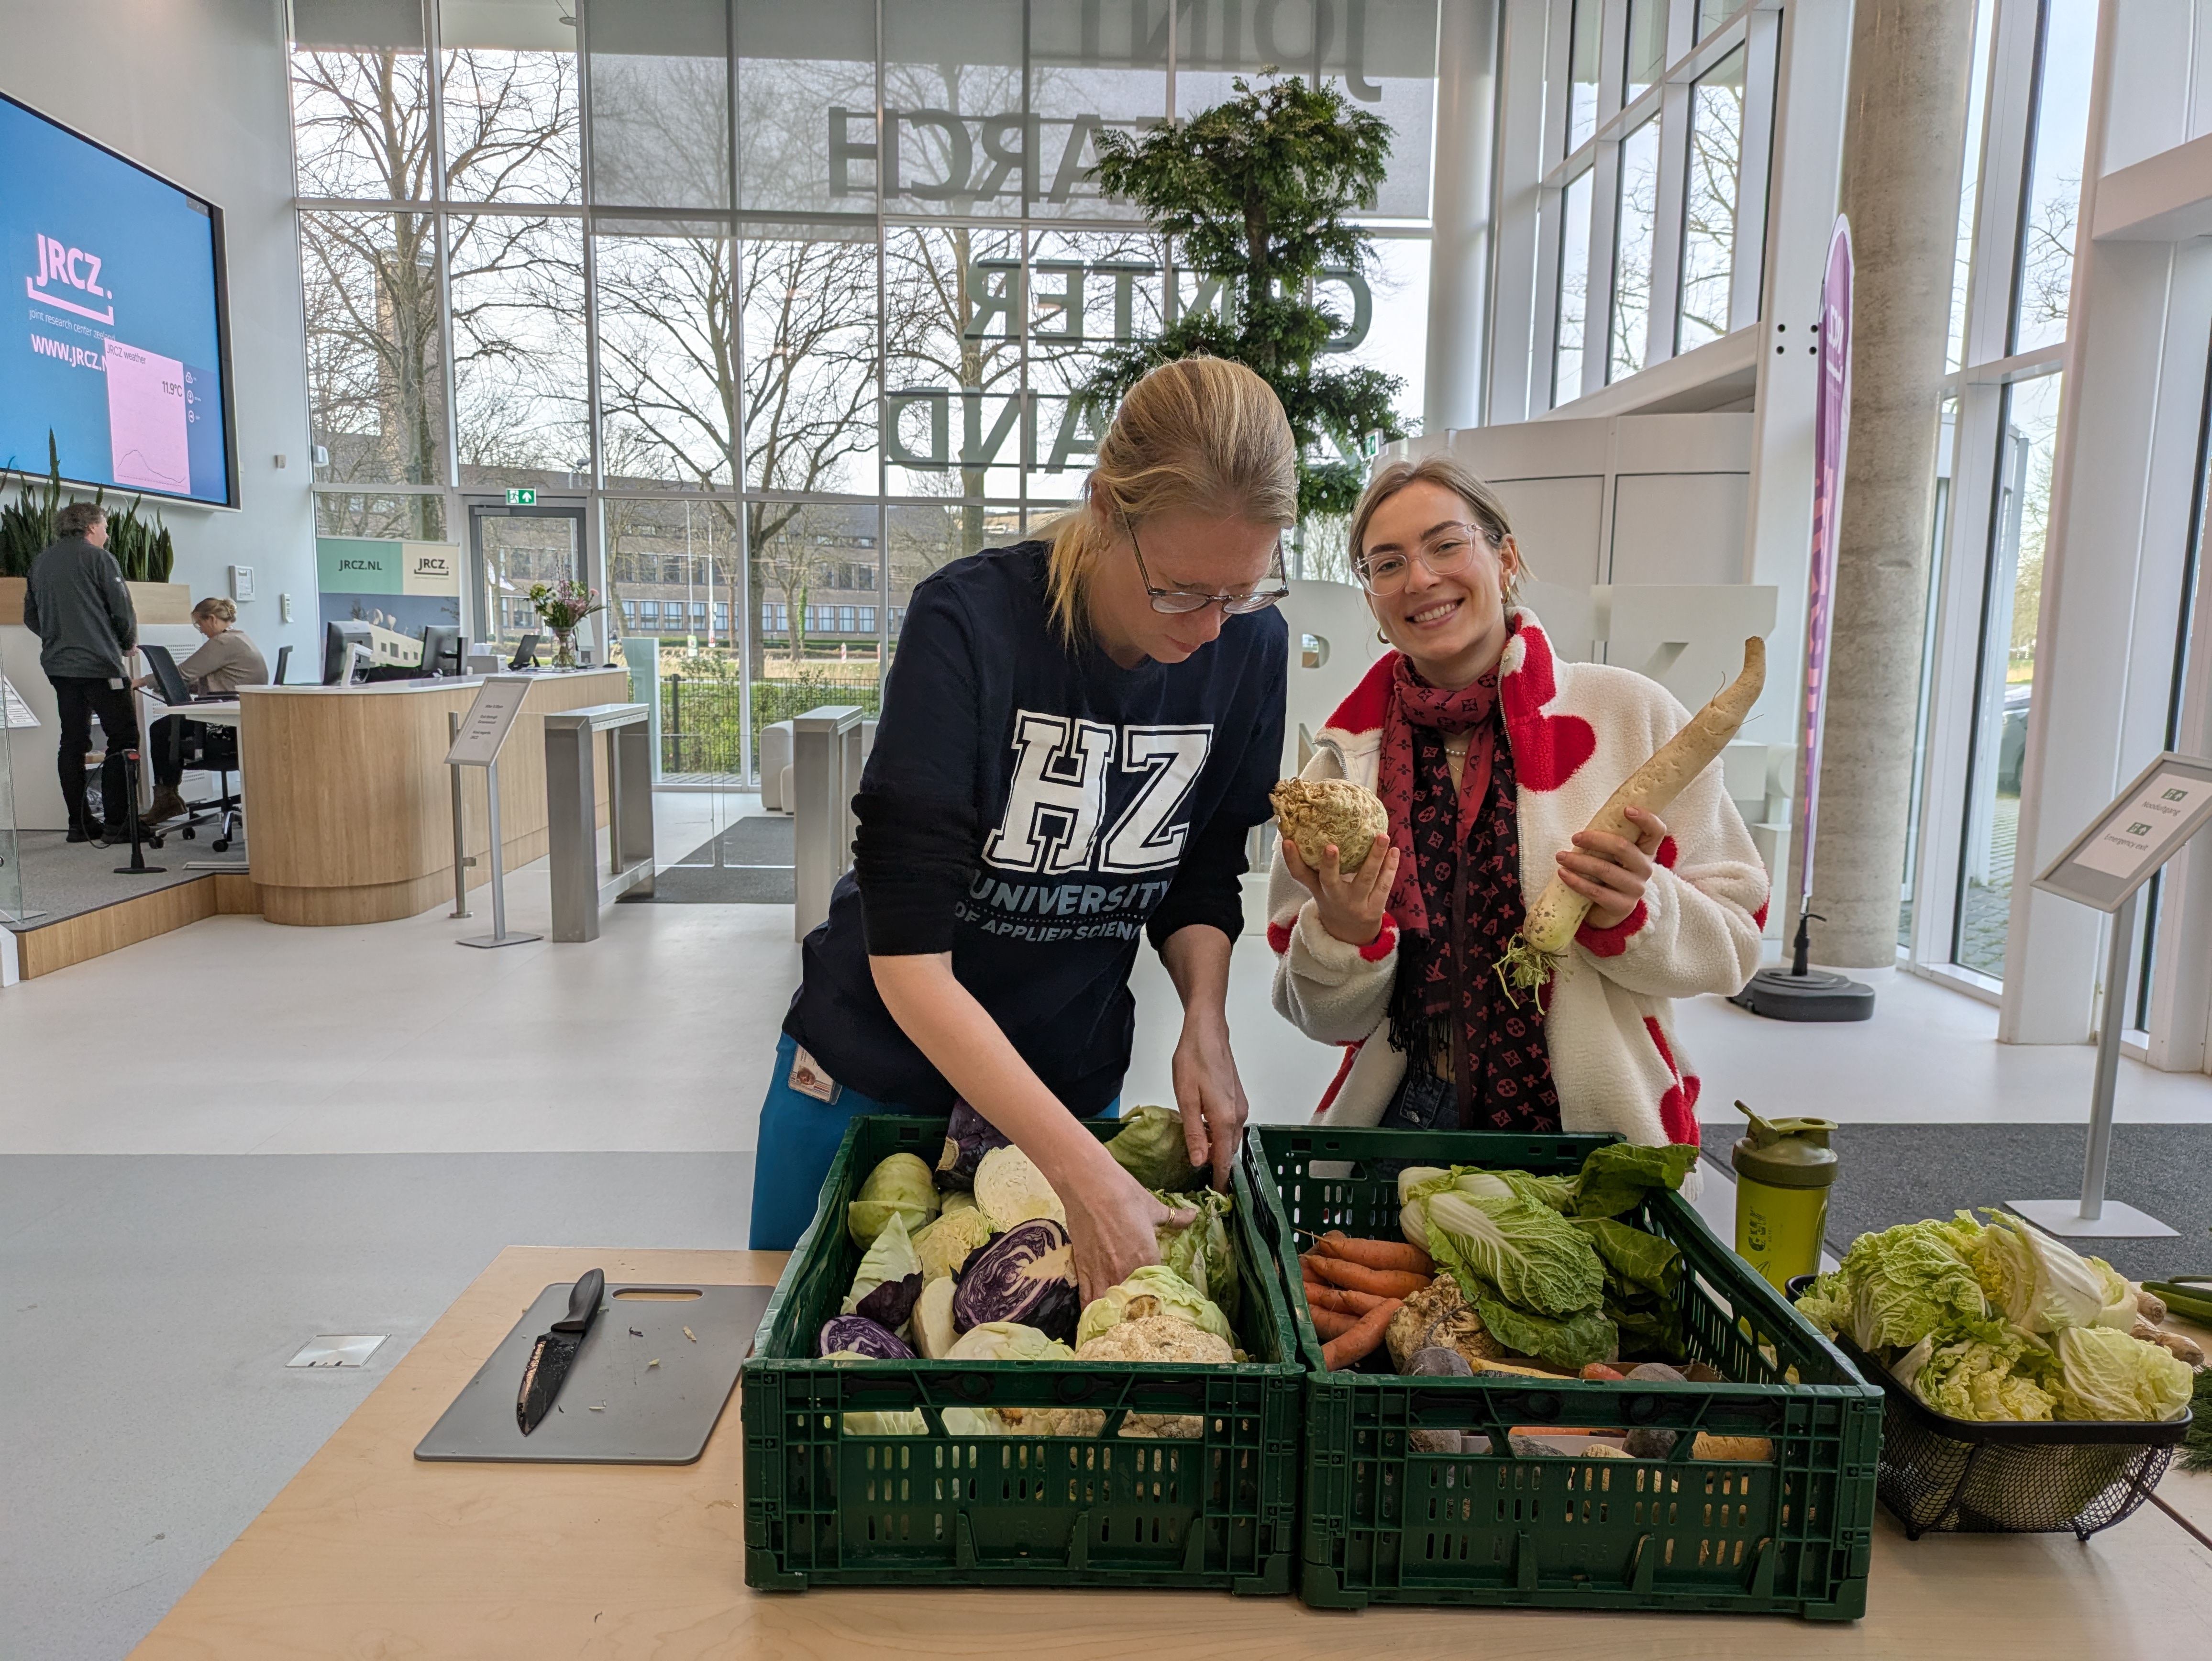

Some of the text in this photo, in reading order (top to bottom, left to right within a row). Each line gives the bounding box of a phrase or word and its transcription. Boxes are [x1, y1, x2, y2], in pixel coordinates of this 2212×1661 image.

[29, 309, 44, 321] joint
[45, 314, 72, 331] research
[74, 323, 92, 336] center
[107, 344, 146, 365] JRCZ weather
[339, 560, 382, 571] JRCZ.NL
[982, 709, 1214, 875] HZ
[2104, 833, 2135, 849] Emergency
[954, 899, 981, 922] OF
[981, 919, 1073, 942] APPLIED
